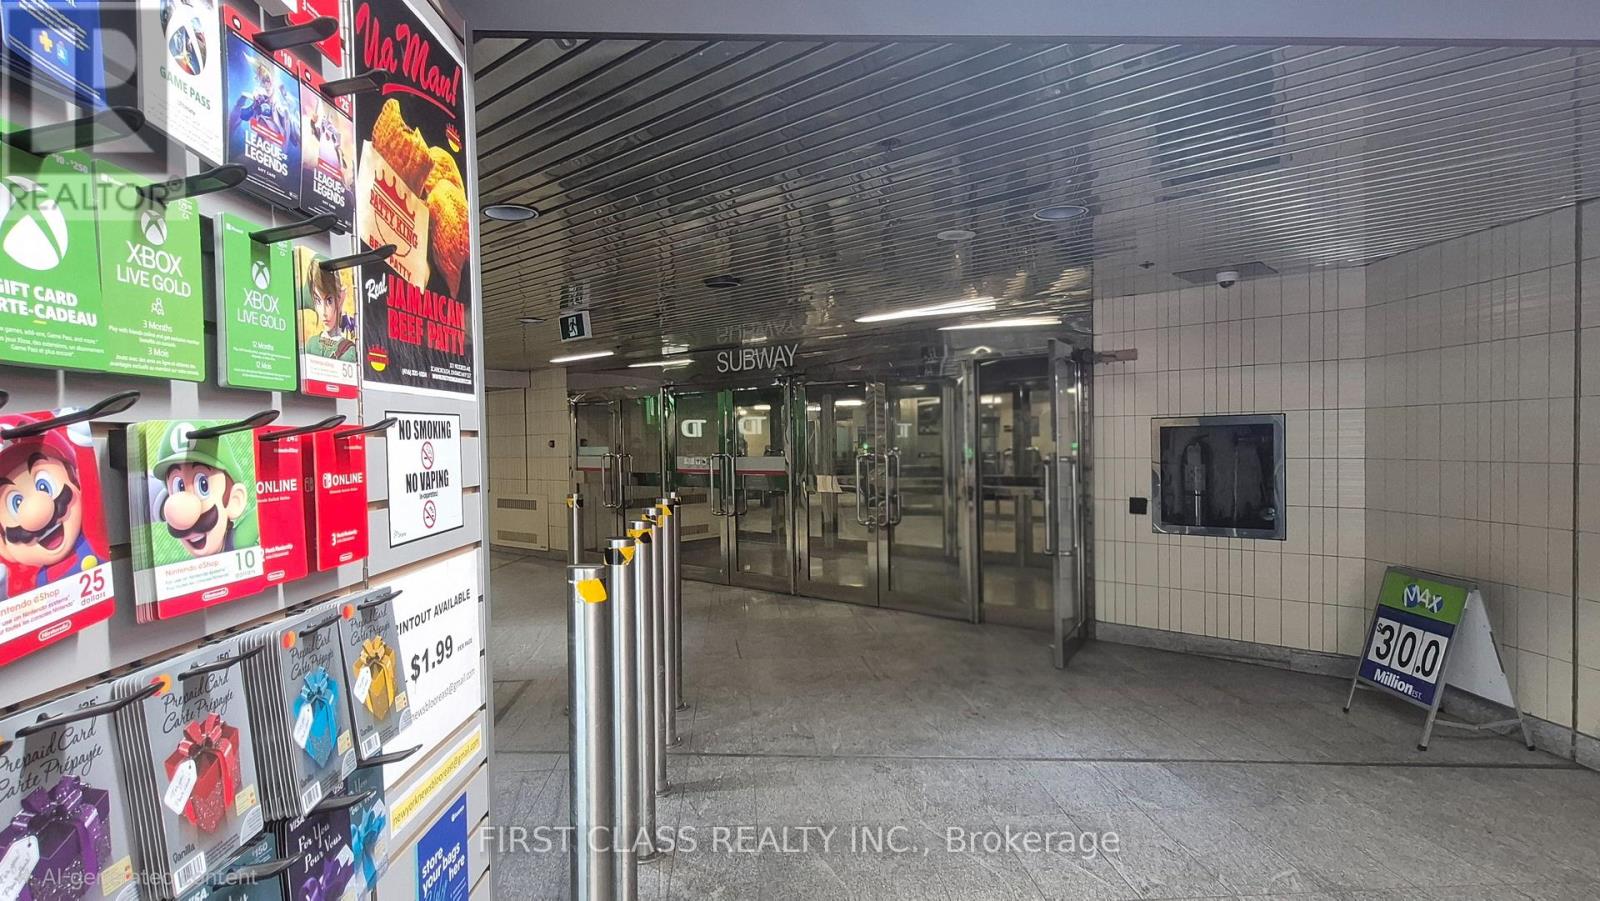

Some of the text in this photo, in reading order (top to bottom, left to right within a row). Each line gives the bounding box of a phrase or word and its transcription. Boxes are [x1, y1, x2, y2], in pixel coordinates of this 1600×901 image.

[159, 66, 211, 111] GAME PASS
[244, 143, 289, 177] LEGENDS
[245, 129, 283, 162] LEAGUE
[313, 167, 342, 194] LEAGUE
[313, 180, 346, 207] LEGENDS
[370, 188, 419, 250] PATTY KING
[125, 240, 184, 278] XBOX
[116, 263, 192, 298] LIVE GOLD
[365, 271, 388, 304] Real
[33, 285, 78, 307] CARD
[243, 287, 280, 315] XBOX
[386, 273, 465, 332] JAMAICAN
[143, 320, 173, 333] 3 Months
[237, 307, 287, 332] LIVE GOLD
[387, 307, 465, 357] BEEF PATTY
[342, 362, 354, 379] 50
[716, 343, 799, 373] SUBWAY
[398, 419, 452, 441] NO SMOKING
[256, 478, 298, 495] ONLINE
[332, 472, 363, 486] ONLINE
[405, 469, 449, 494] NO VAPING
[235, 549, 256, 571] 10
[33, 588, 60, 604] eShop
[79, 568, 105, 599] 25
[81, 591, 106, 607] dollars
[396, 588, 471, 636] INTOUT AVAILABLE
[410, 634, 453, 685] $1.99
[161, 667, 229, 715] Prepaid Card
[1374, 668, 1414, 695] Million
[57, 716, 97, 751] Card
[162, 708, 195, 734] Carte
[298, 822, 330, 853] For You
[304, 833, 342, 874] Pour Vous
[421, 847, 443, 880] store
[448, 854, 465, 883] here
[422, 863, 441, 899] your
[442, 842, 461, 872] bags
